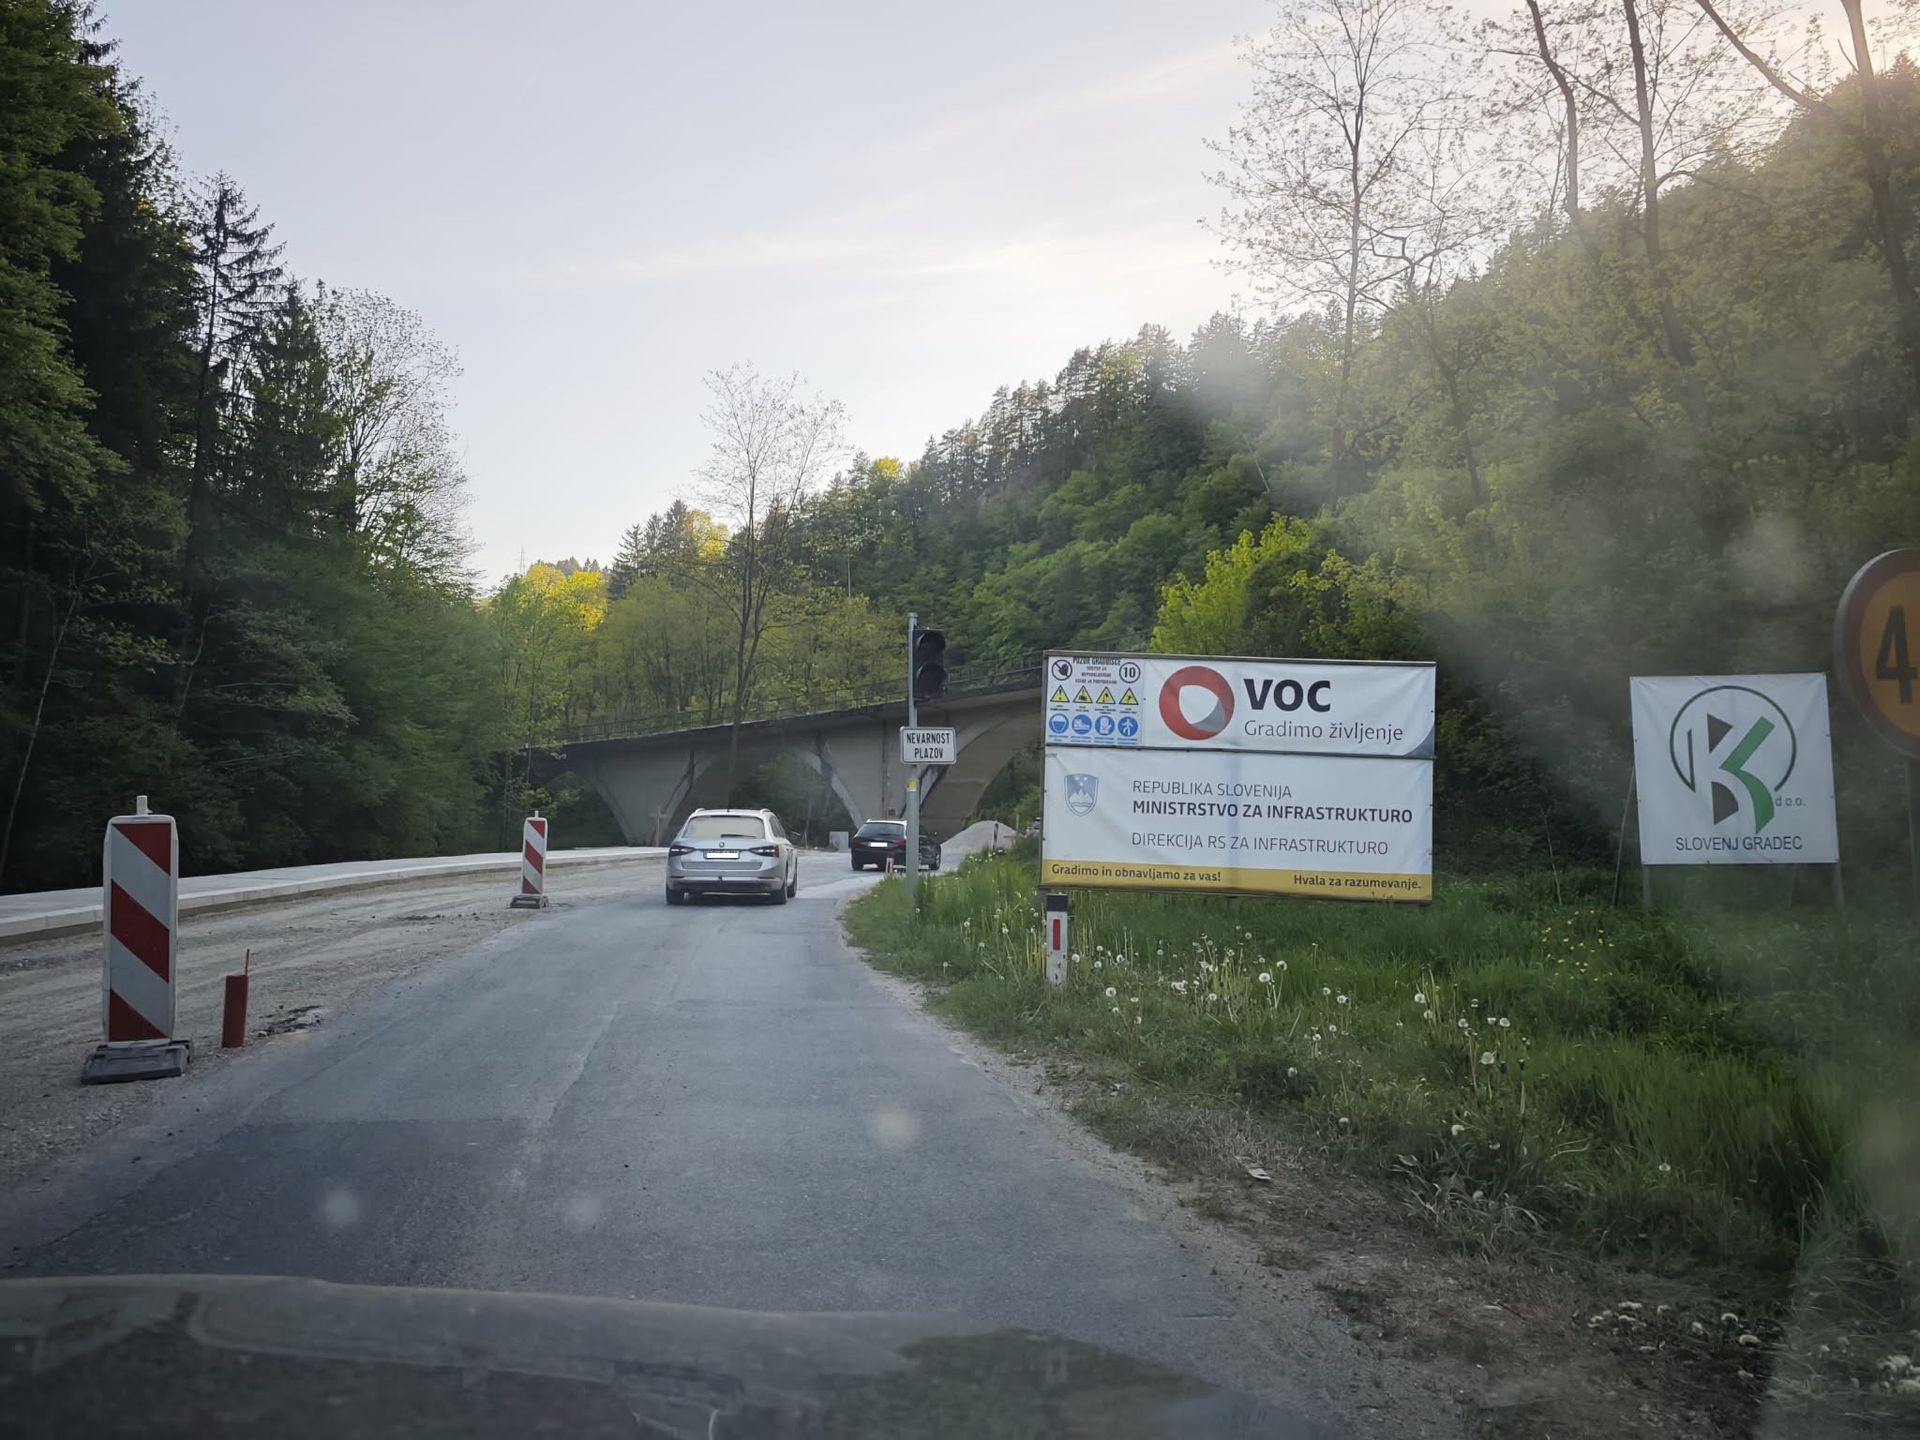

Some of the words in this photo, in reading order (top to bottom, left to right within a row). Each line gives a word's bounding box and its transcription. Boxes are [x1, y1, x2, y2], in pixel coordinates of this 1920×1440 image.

[1124, 667, 1136, 678] 10
[1243, 678, 1331, 713] VOC
[906, 732, 950, 744] NEVARNOST
[1244, 720, 1323, 738] Gradimo
[1329, 722, 1403, 745] življenje
[914, 747, 943, 759] PLAZOV
[1132, 780, 1213, 796] REPUBLIKA
[1217, 783, 1292, 800] SLOVENIJA
[1132, 800, 1238, 817] MINISTRSTVO
[1242, 804, 1263, 818] ZA
[1267, 805, 1413, 823] INFRASTRUKTURO
[1131, 832, 1203, 850] DIREKCIJA
[1207, 835, 1226, 848] RS
[1230, 836, 1249, 850] ZA
[1253, 837, 1388, 855] INFRASTRUKTURO
[1675, 837, 1739, 850] SLOVENJ
[1742, 836, 1803, 850] GRADEC
[1051, 863, 1099, 876] Gradimo
[1101, 866, 1112, 877] in
[1115, 868, 1180, 880] obnavljamo
[1183, 872, 1196, 881] za
[1198, 871, 1221, 882] vas!
[1294, 874, 1326, 886] Hvala
[1328, 878, 1342, 887] za
[1344, 878, 1421, 891] razumevanje.
